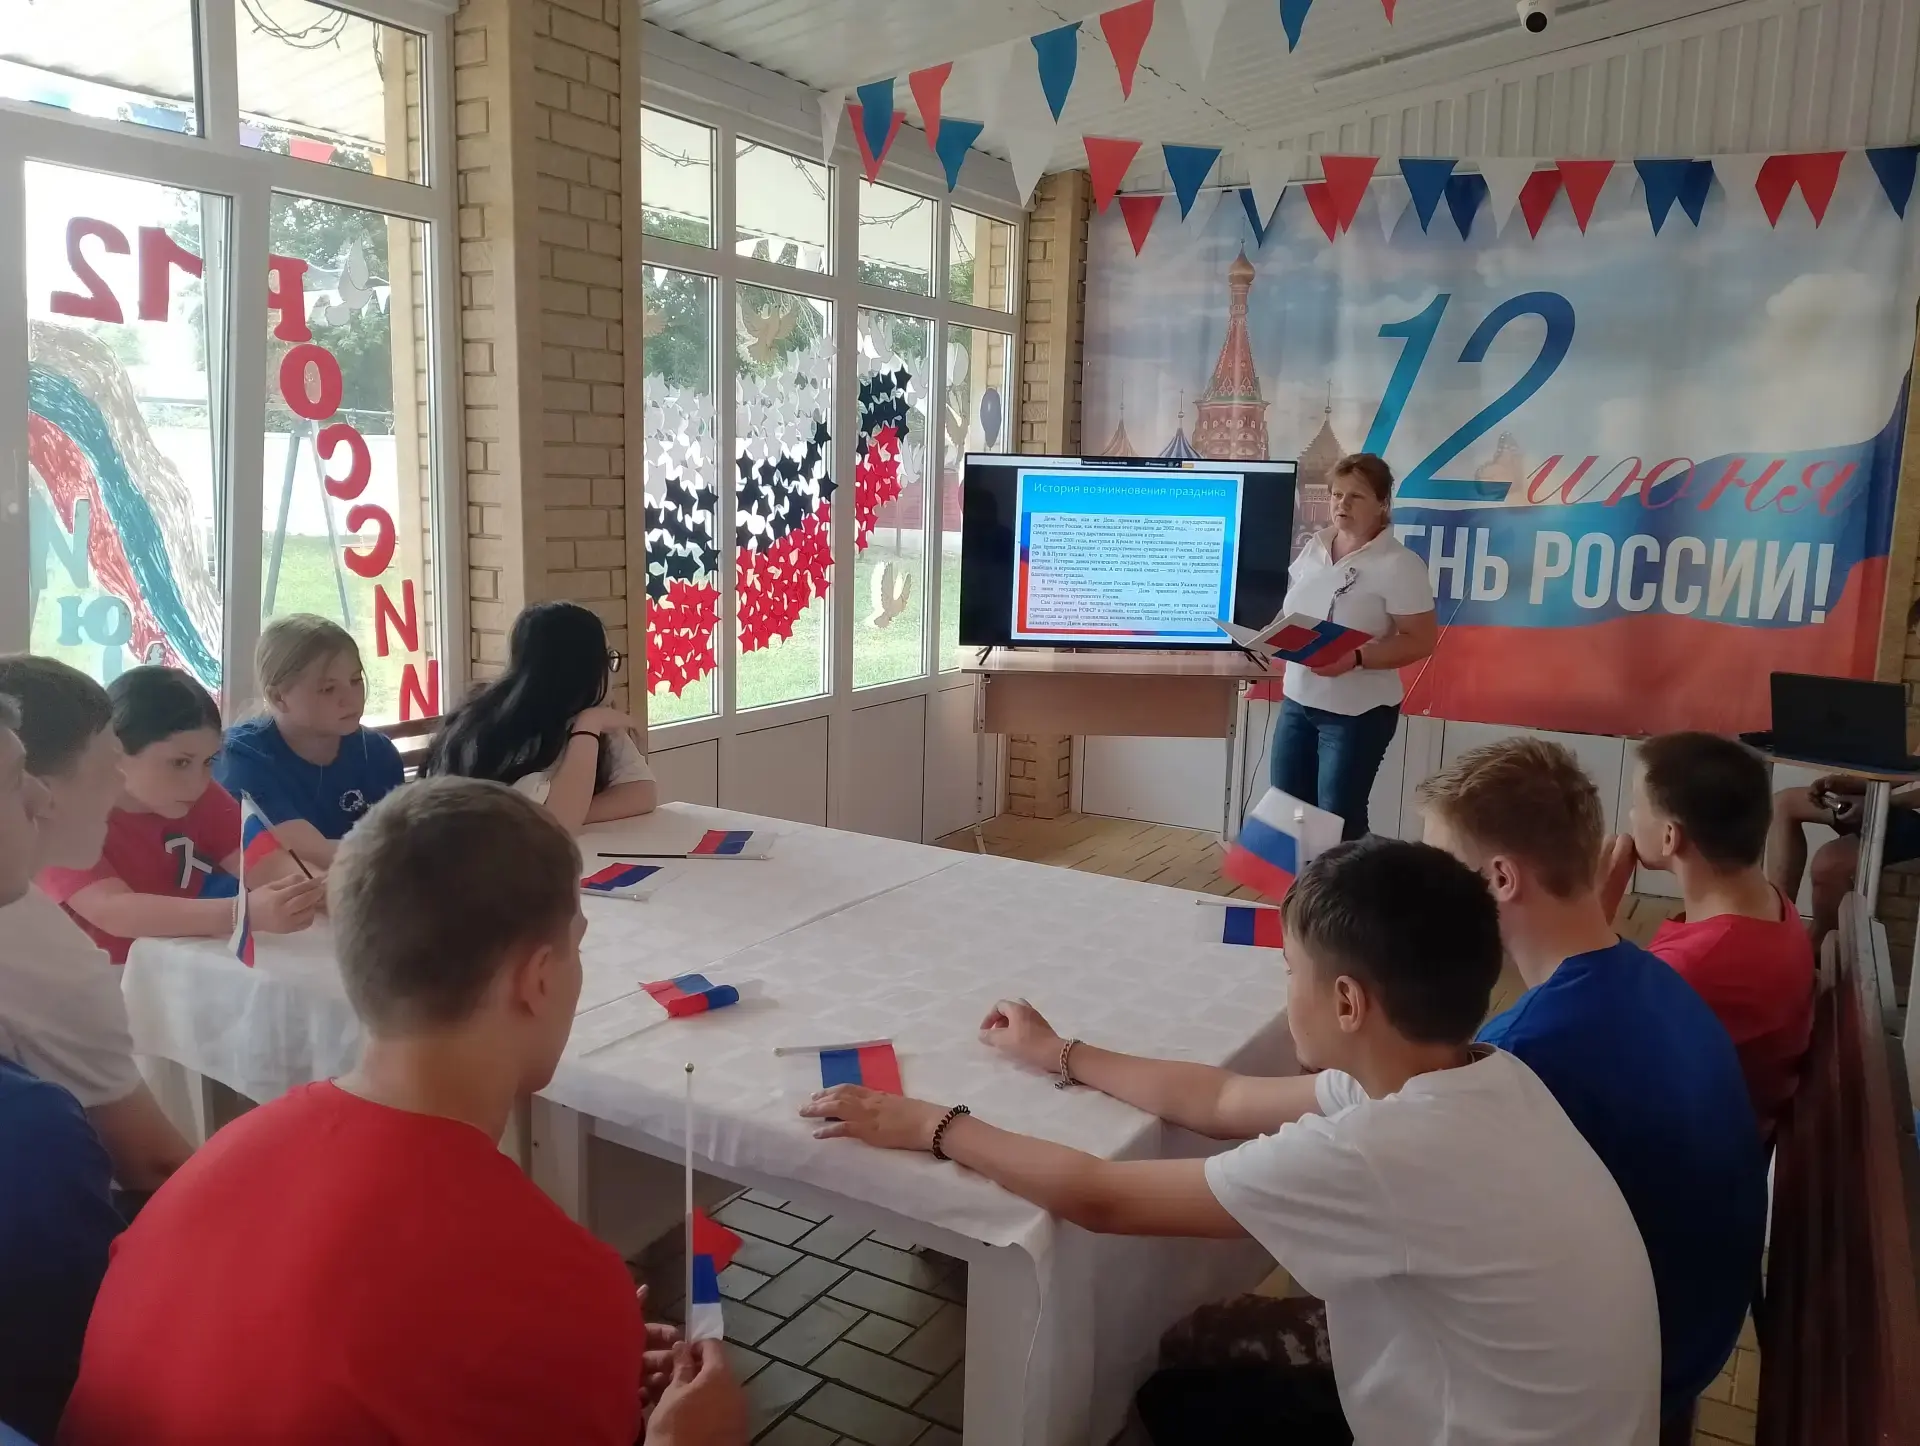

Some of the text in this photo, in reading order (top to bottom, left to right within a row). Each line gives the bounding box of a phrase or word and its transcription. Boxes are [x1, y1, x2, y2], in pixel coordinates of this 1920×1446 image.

[1361, 291, 1860, 516] 12 июня
[1034, 482, 1226, 498] История возникновения праздника
[1394, 522, 1835, 624] НЬ РОССИИ!
